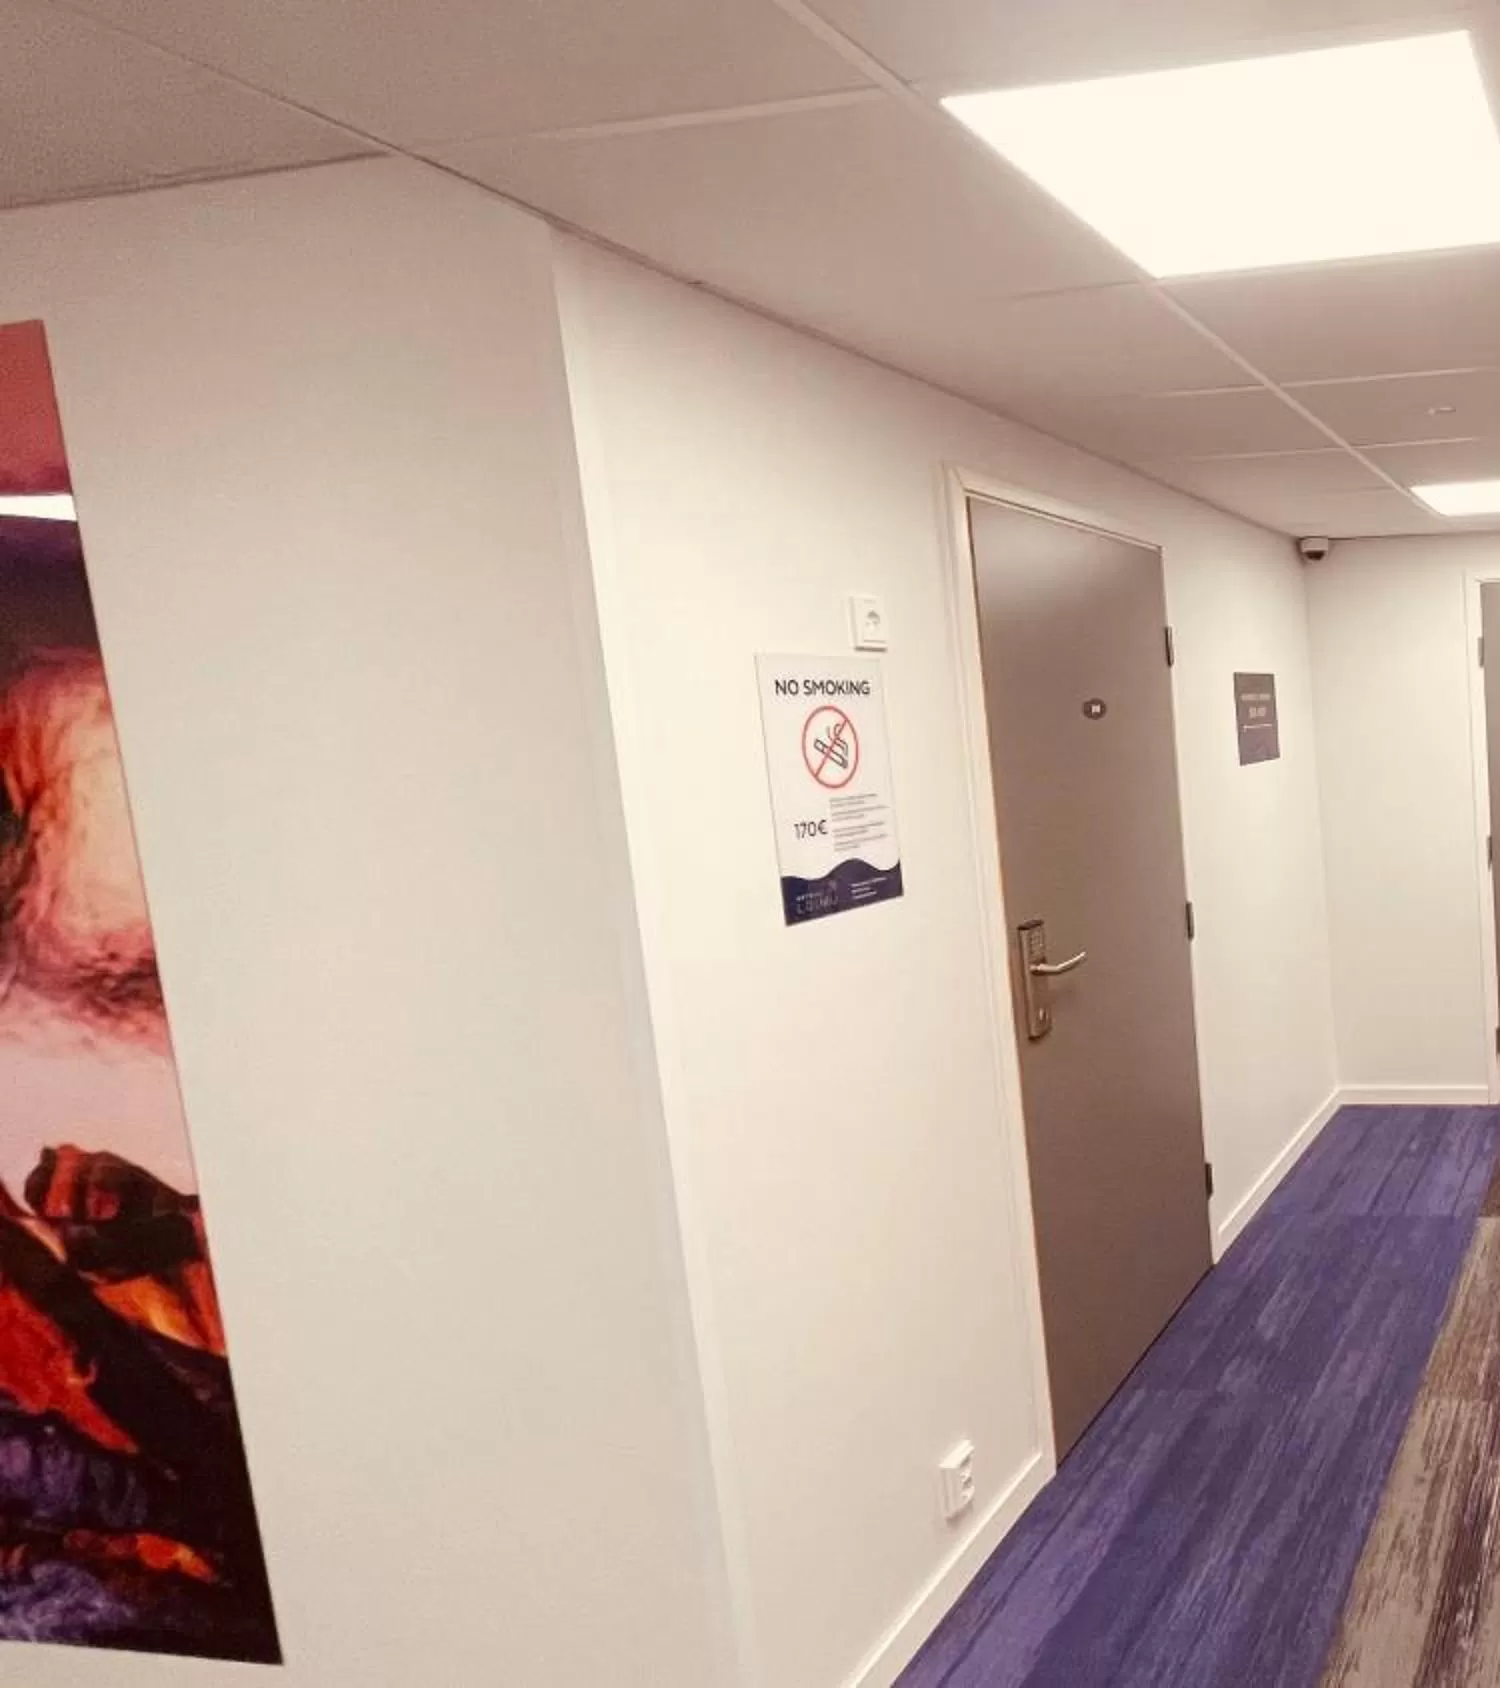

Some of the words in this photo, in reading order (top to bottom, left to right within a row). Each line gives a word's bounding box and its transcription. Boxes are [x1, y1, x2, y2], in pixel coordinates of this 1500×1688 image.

[774, 679, 799, 696] NO
[803, 679, 871, 697] SMOKING
[793, 819, 829, 840] 170€
